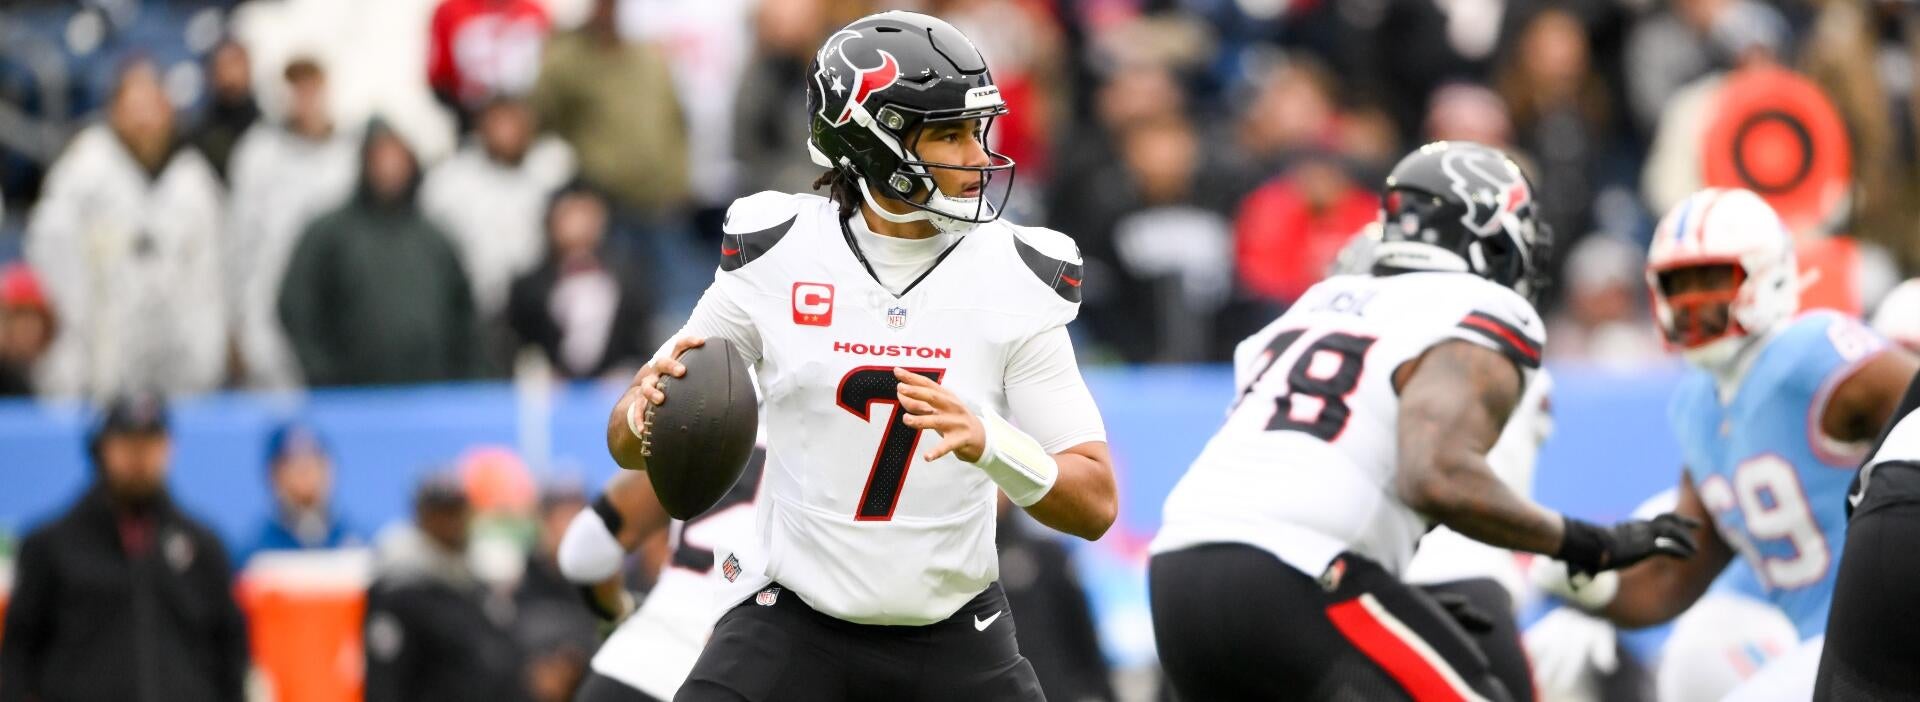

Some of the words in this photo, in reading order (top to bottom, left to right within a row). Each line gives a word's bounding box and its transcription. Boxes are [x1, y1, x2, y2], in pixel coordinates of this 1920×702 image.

[795, 285, 832, 315] C
[833, 341, 952, 359] HOUSTON
[836, 365, 946, 521] 7
[1236, 326, 1380, 443] 78
[1700, 450, 1832, 592] 69
